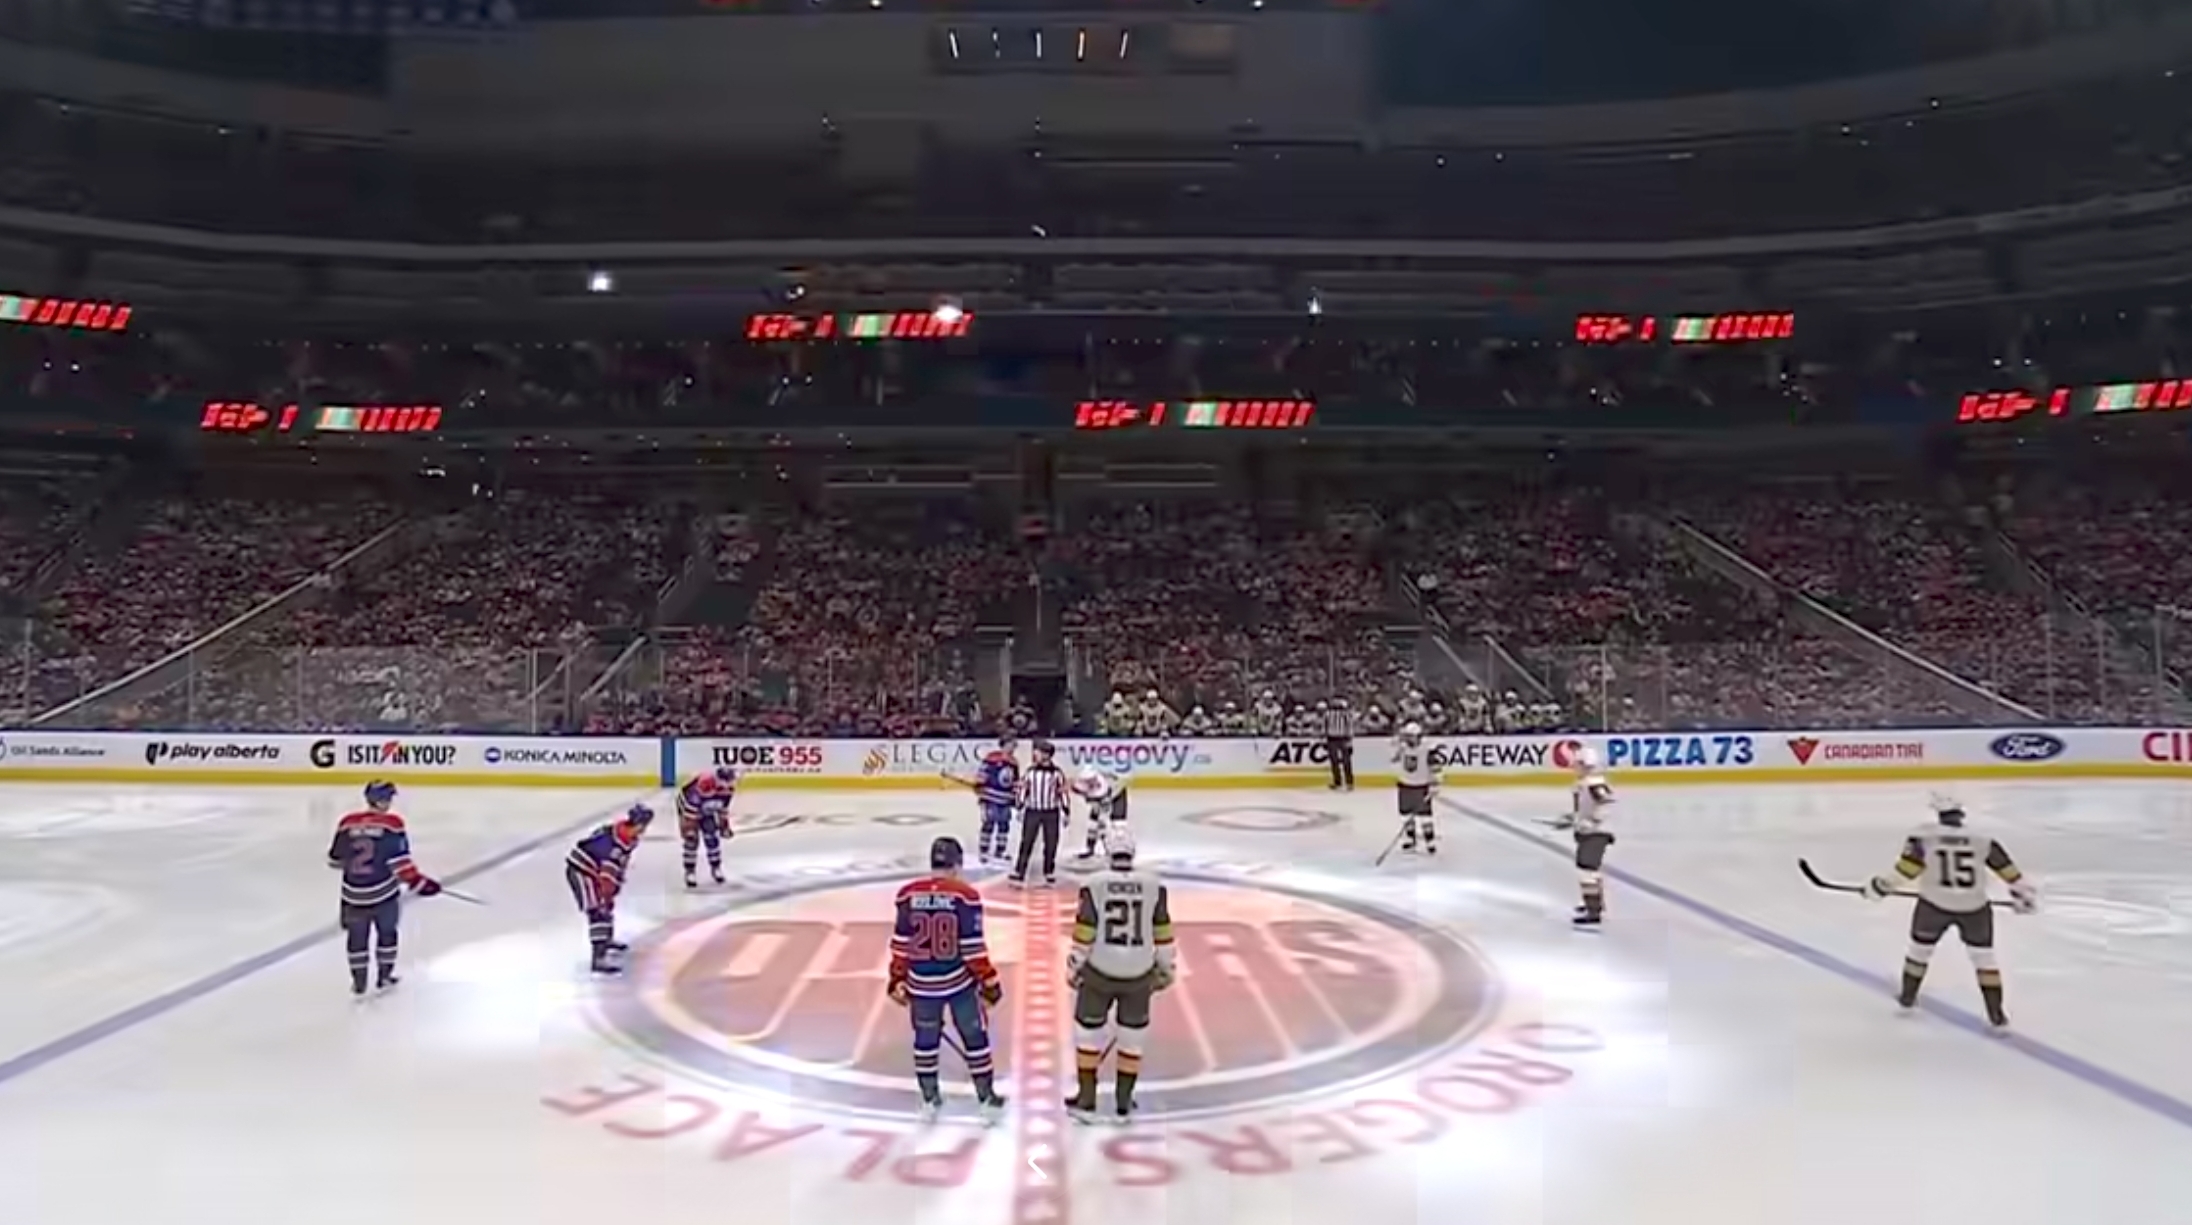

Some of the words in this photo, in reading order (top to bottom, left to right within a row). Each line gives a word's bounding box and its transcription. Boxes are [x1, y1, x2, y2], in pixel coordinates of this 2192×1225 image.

[170, 743, 212, 760] play
[213, 744, 280, 758] alberta
[504, 749, 561, 762] KONICA
[562, 750, 627, 764] MINOLTA
[713, 746, 775, 765] IUOE
[779, 746, 822, 765] 955
[893, 742, 993, 764] LEGAC
[1069, 744, 1189, 772] wegovy
[1436, 744, 1550, 766] SAFEWAY
[1607, 739, 1706, 767] PIZZA
[1713, 737, 1753, 765] 73
[1825, 744, 1894, 759] CANADIAN
[1896, 742, 1923, 759] TIRE
[2002, 737, 2051, 757] Ford
[350, 837, 376, 875] 2
[1935, 850, 1975, 888] 15
[1105, 900, 1144, 946] 21
[909, 911, 959, 961] 28
